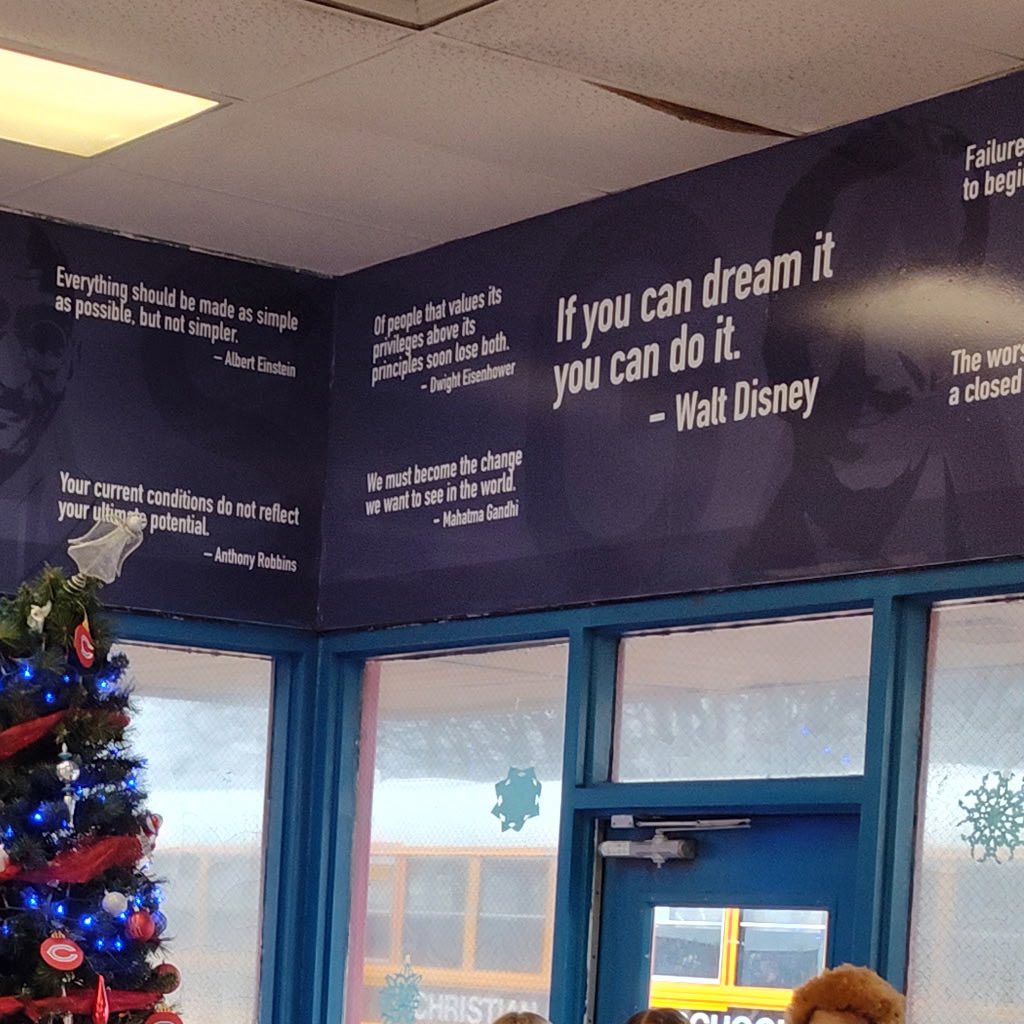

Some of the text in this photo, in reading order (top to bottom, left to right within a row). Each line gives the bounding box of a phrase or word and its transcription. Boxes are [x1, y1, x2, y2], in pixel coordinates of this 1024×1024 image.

[965, 138, 1024, 171] Failure
[963, 161, 1024, 201] to begi
[56, 266, 298, 334] Everything should be made as simple
[374, 285, 503, 338] Of people that values its
[556, 231, 836, 349] If you can dream it
[55, 295, 239, 345] as possible, but not simpler.
[372, 317, 476, 364] privileges above its
[224, 350, 255, 372] Albert
[257, 356, 296, 378] Einstein
[371, 331, 510, 387] principles soon lose both.
[429, 371, 461, 394] Dwight
[462, 361, 516, 385] Eisenhower
[553, 316, 741, 410] you can do it.
[951, 348, 982, 376] The
[675, 387, 728, 433] Walt
[733, 376, 820, 420] Disney
[948, 367, 1023, 406] a closed
[365, 471, 516, 516] we want to see in the world.
[367, 450, 523, 493] We must become the change
[58, 500, 90, 522] your
[150, 513, 209, 537] potential.
[59, 471, 300, 526] Your current conditions do not reflect
[442, 507, 484, 528] Mahatma
[486, 499, 519, 522] Gandhi
[215, 547, 255, 571] Anthony
[258, 552, 297, 573] Robbins
